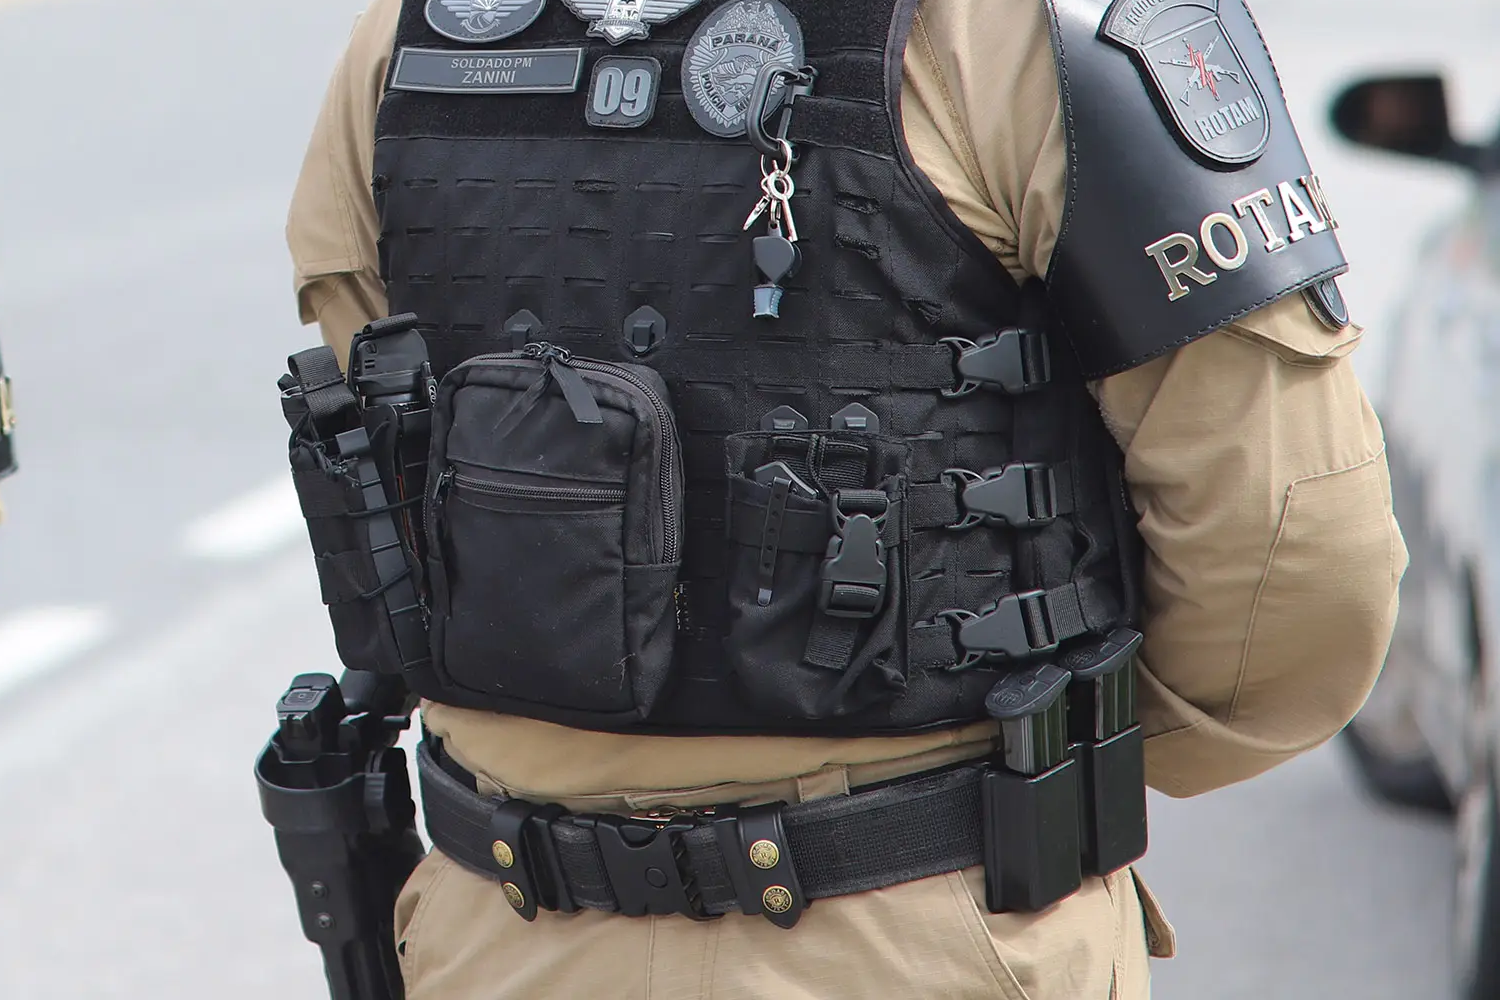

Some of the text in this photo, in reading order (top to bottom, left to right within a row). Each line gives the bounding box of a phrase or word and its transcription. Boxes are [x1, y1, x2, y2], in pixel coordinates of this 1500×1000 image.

[450, 57, 533, 69] SOLDADO PM
[461, 70, 517, 84] ZANINI
[592, 66, 652, 117] 09
[1194, 96, 1261, 142] ROTAM
[1143, 174, 1340, 303] ROTAM
